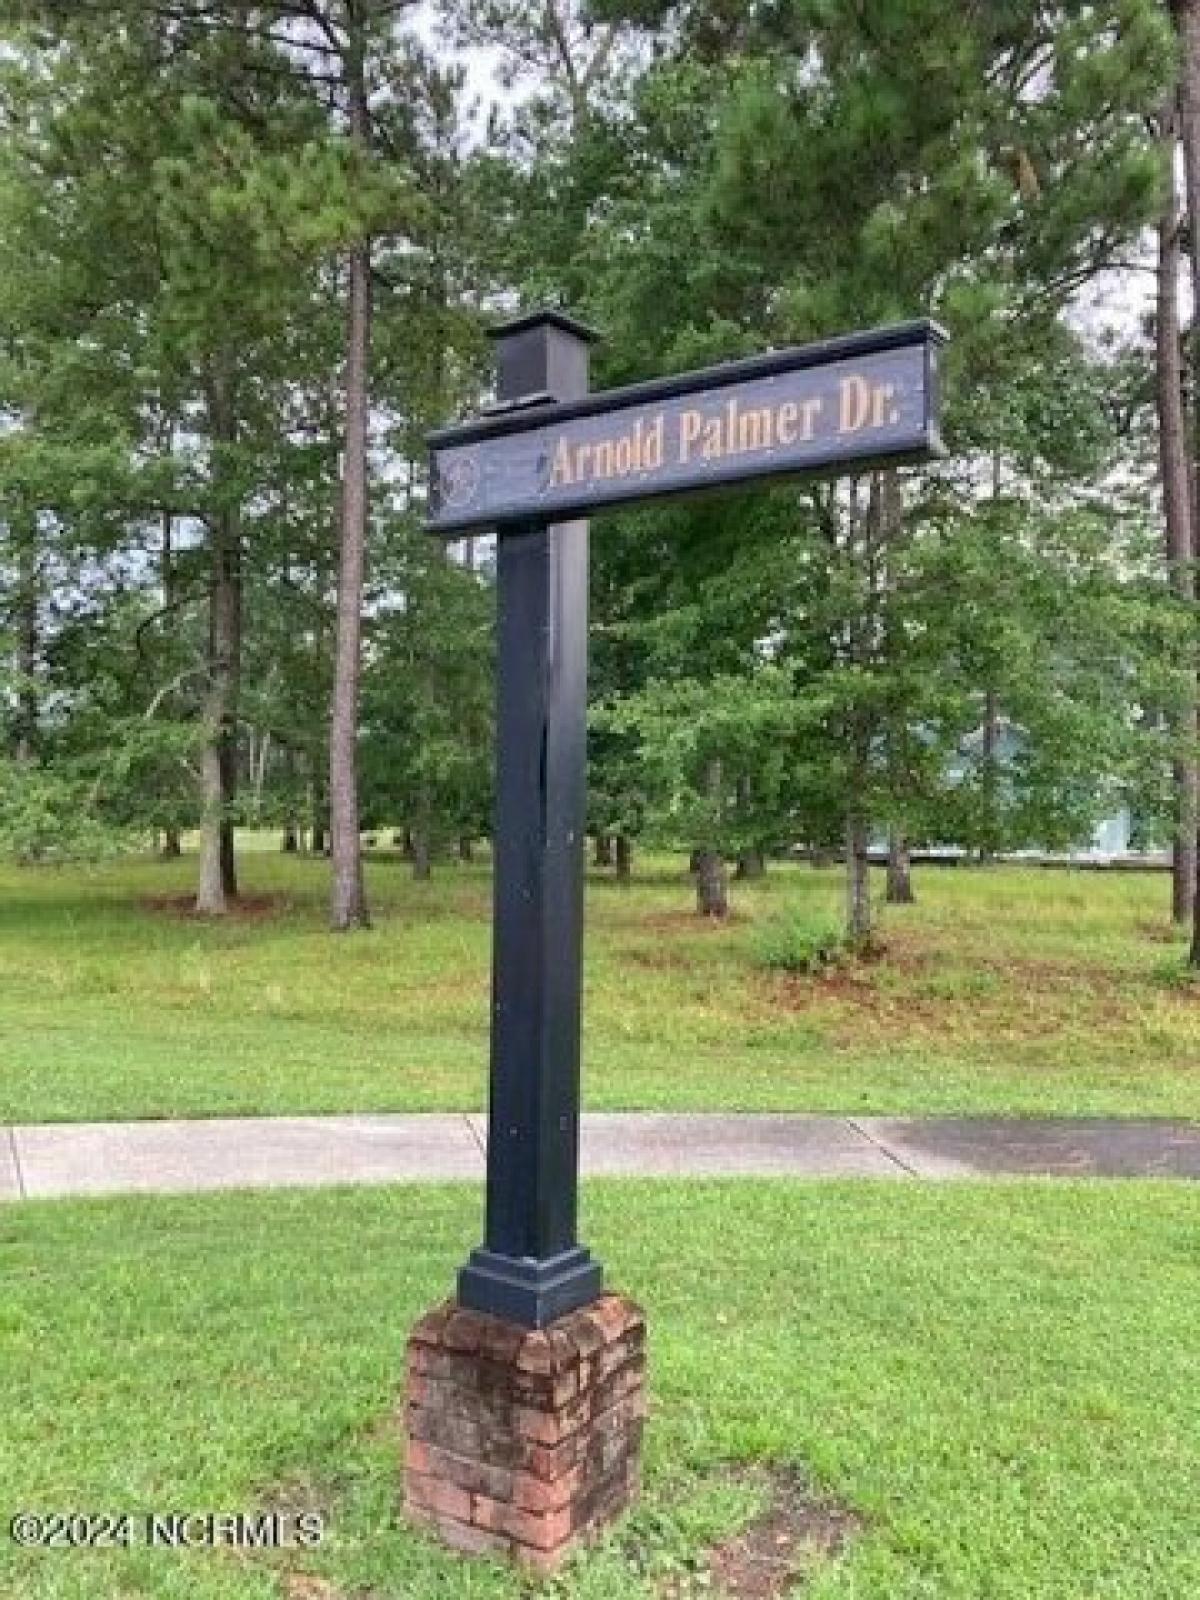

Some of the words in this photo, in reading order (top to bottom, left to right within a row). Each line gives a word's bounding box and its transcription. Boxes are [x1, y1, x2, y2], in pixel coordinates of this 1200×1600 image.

[548, 416, 665, 486] Arnold
[679, 398, 823, 462] Palmer
[839, 376, 899, 434] Dr.
